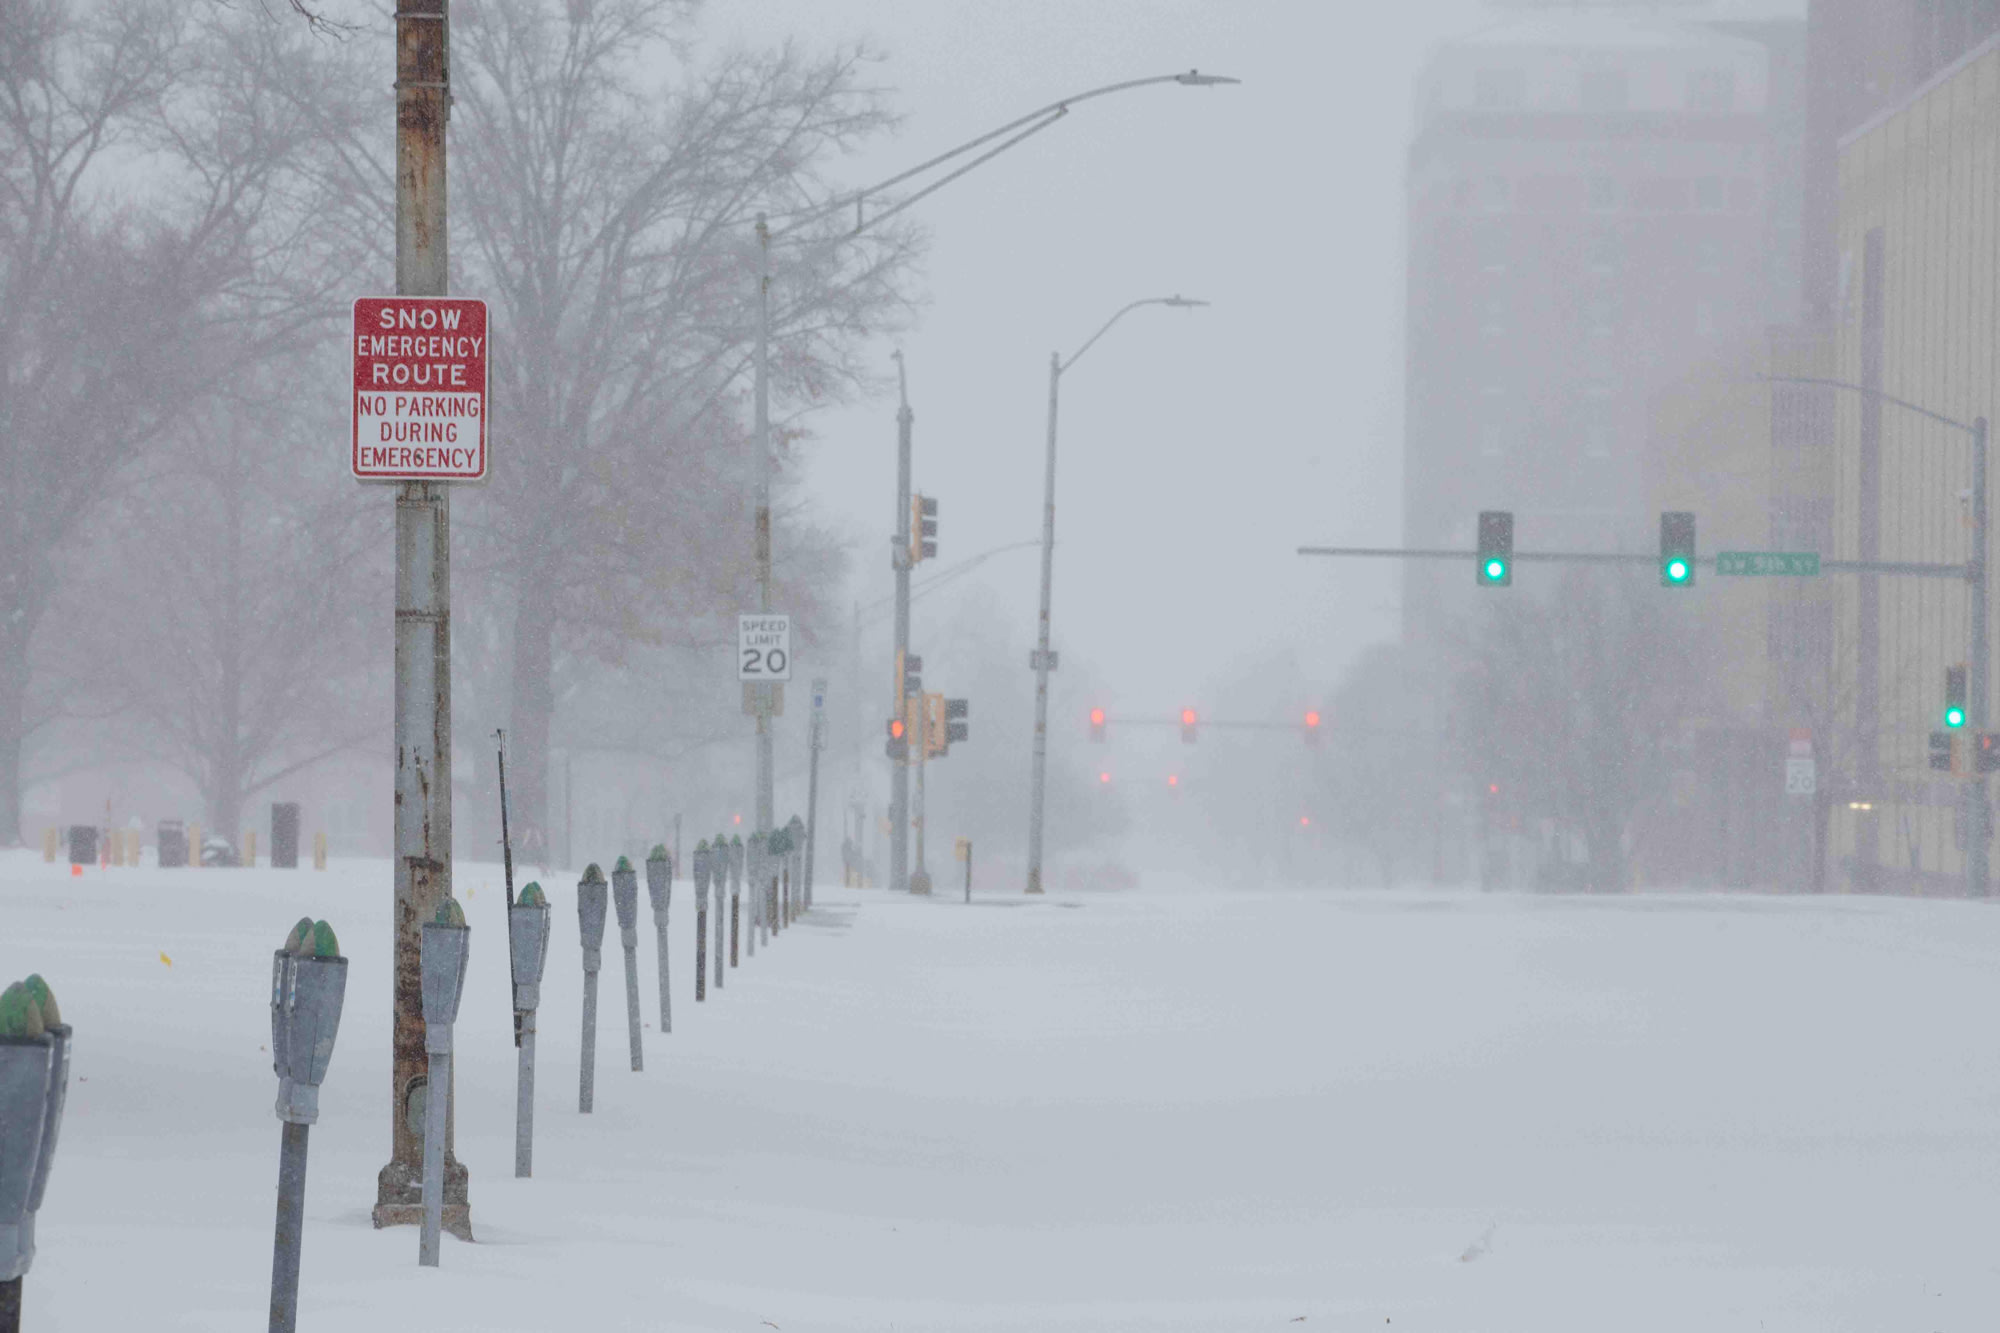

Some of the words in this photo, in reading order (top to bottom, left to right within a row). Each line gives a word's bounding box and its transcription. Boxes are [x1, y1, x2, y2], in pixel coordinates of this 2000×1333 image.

[379, 307, 461, 330] SNOW
[358, 335, 483, 358] EMERGENCY
[372, 363, 467, 385] ROUTE
[359, 396, 387, 416] NO
[395, 396, 479, 418] PARKING
[380, 422, 458, 443] DURING
[360, 447, 476, 469] EMERGENCY
[742, 620, 787, 632] SPEED
[746, 634, 782, 645] LIMIT
[742, 648, 787, 673] 20
